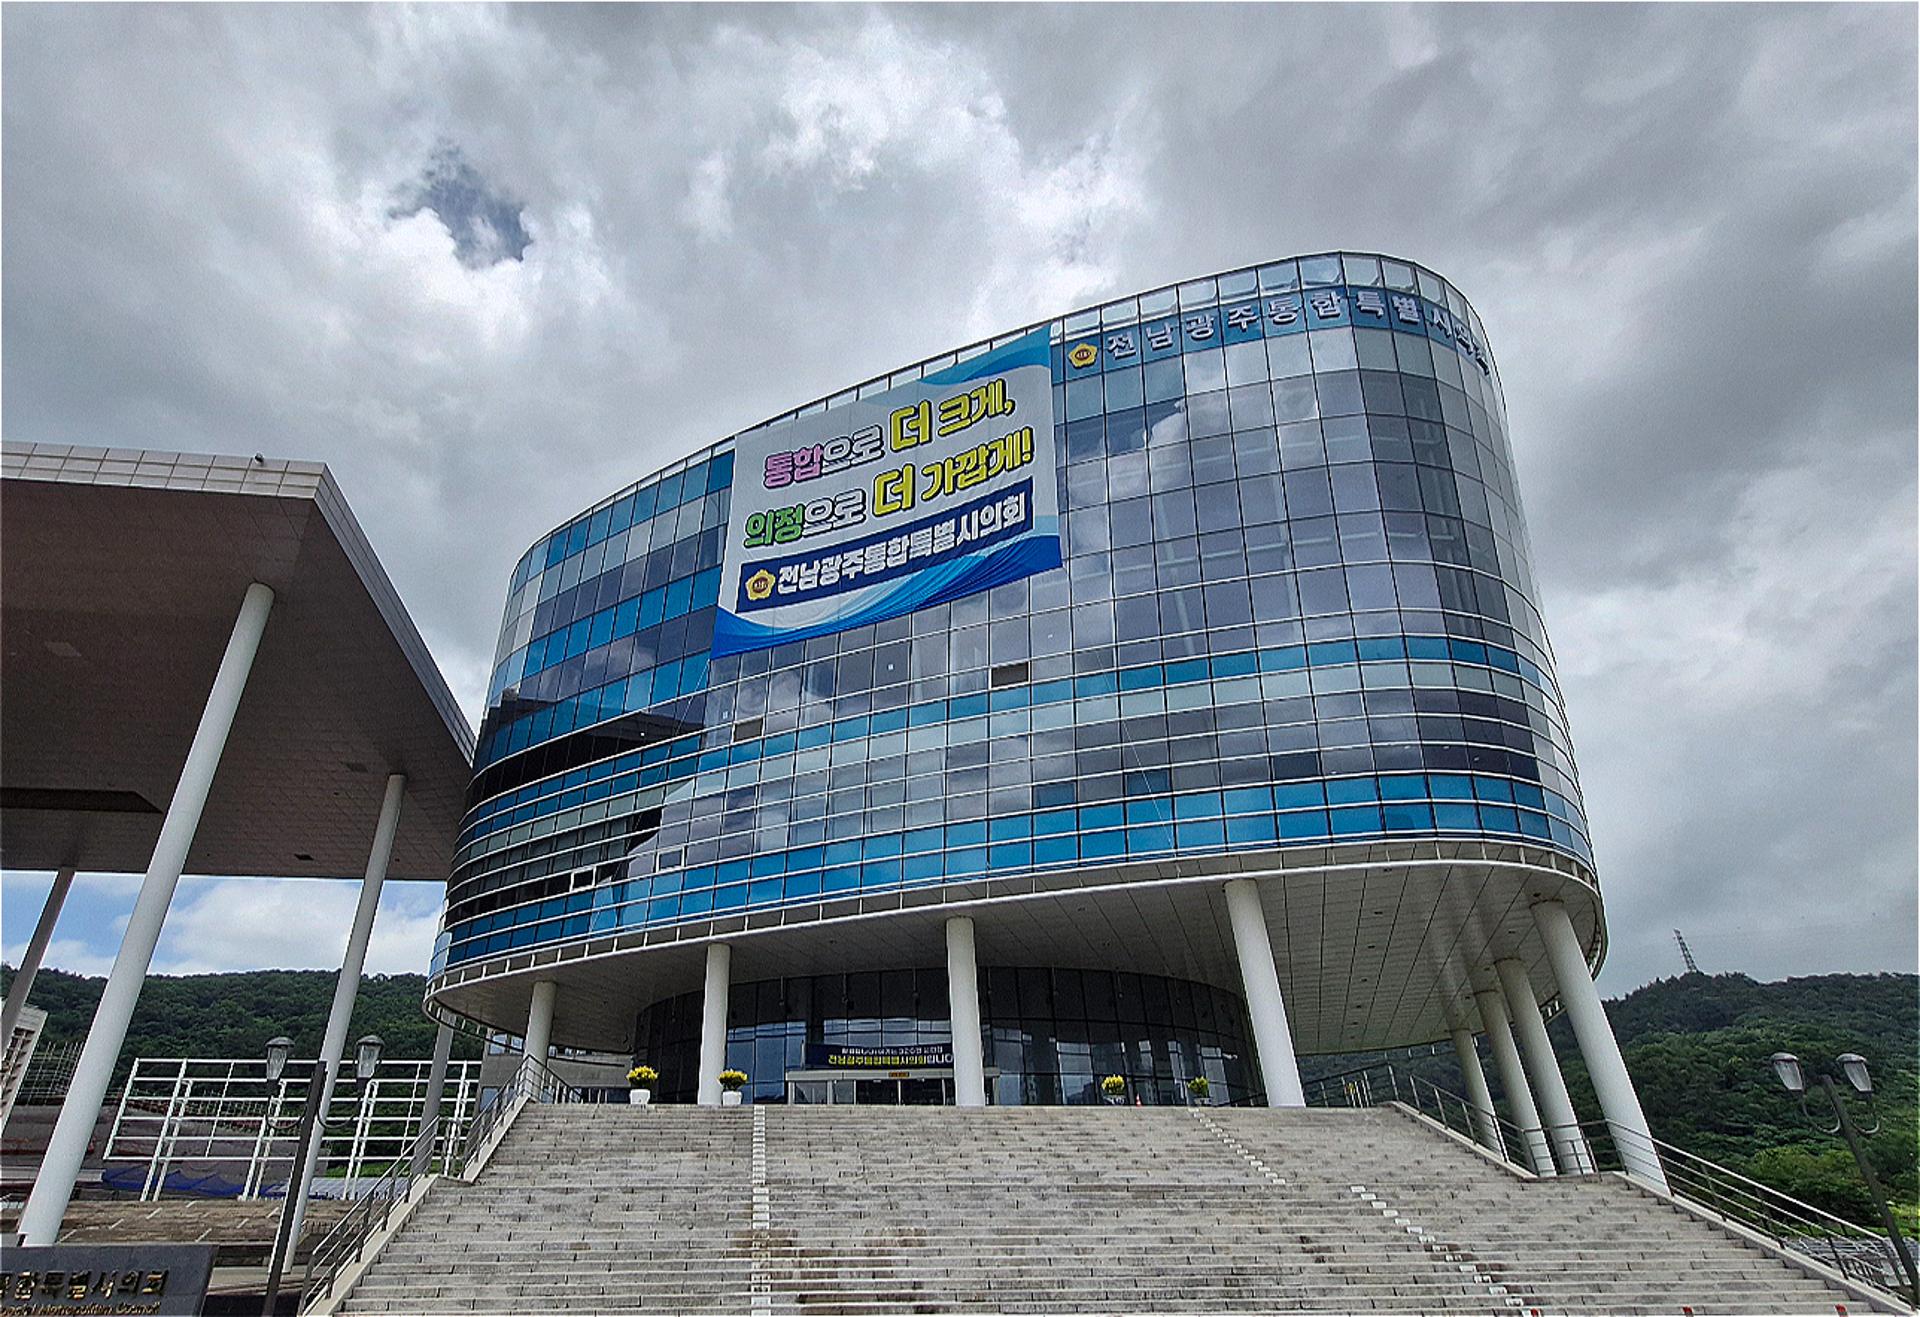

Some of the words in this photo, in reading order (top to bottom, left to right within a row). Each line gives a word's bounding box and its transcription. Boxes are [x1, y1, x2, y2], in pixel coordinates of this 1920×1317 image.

[744, 489, 866, 548] 의정으로
[872, 463, 916, 517] 더
[922, 426, 1035, 502] 가깝게!
[763, 425, 883, 489] 통합으로
[889, 400, 934, 452] 더
[937, 379, 1016, 436] 크게,
[777, 493, 1026, 595] 전남광주통합특별시의회
